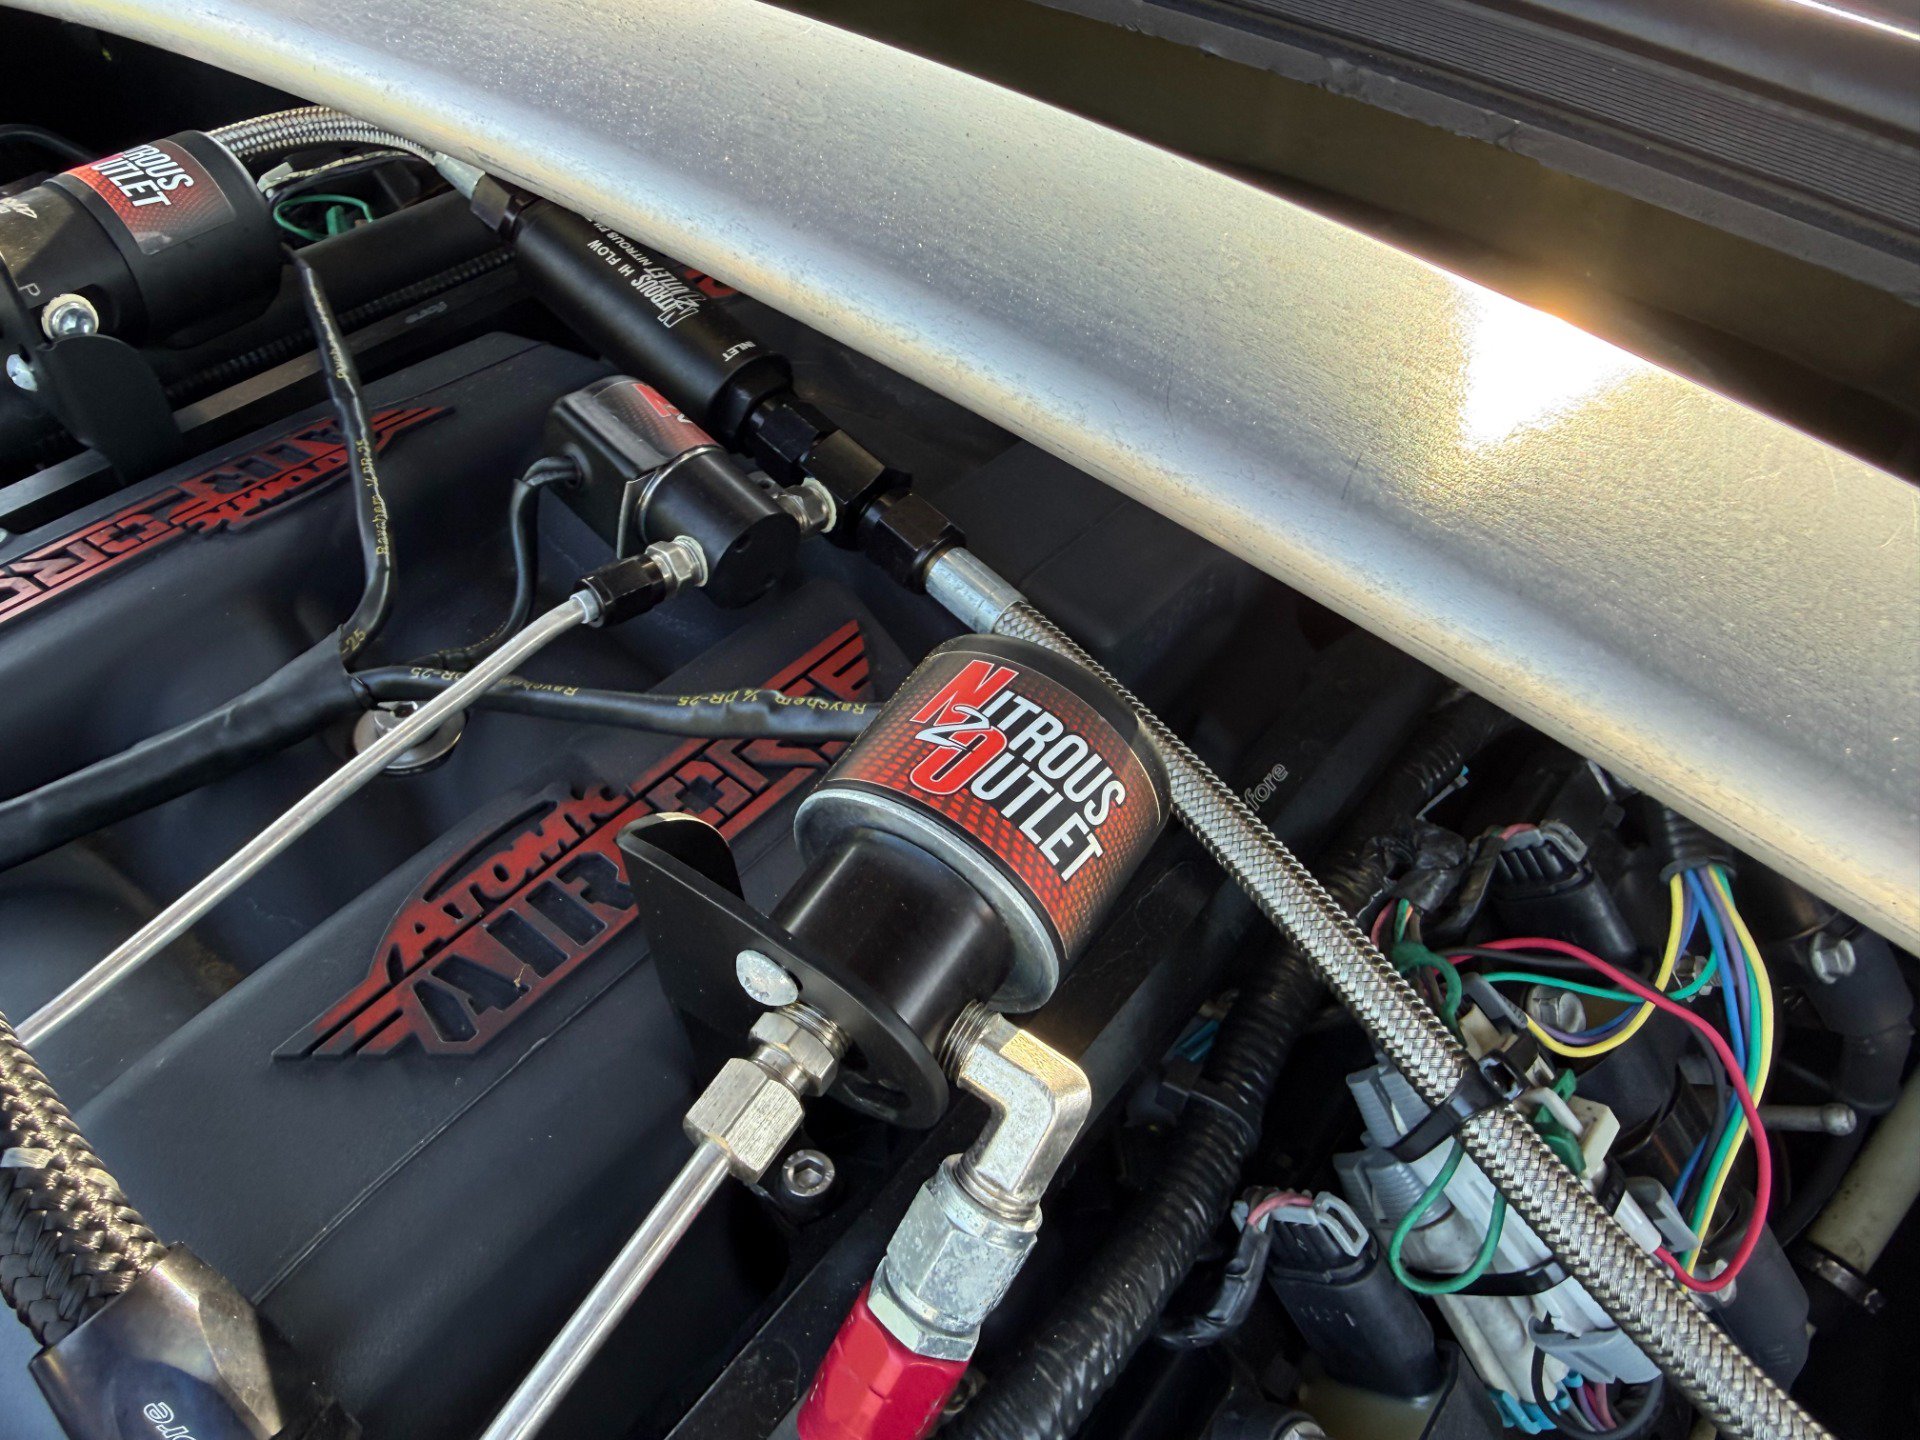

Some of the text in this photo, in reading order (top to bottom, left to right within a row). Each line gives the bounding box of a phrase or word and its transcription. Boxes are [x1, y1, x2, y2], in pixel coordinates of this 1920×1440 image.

[91, 157, 172, 207] UTLET
[587, 239, 636, 277] HI FLOW
[606, 231, 653, 266] NITROUS
[630, 274, 699, 328] NITROUS
[722, 341, 757, 362] INLET
[677, 690, 739, 707] DR-25
[774, 693, 867, 715] Raychem
[908, 659, 1127, 827] NITROUS
[909, 725, 1104, 883] OUTLET
[1243, 763, 1289, 812] fore
[386, 784, 632, 968] ATOMIC
